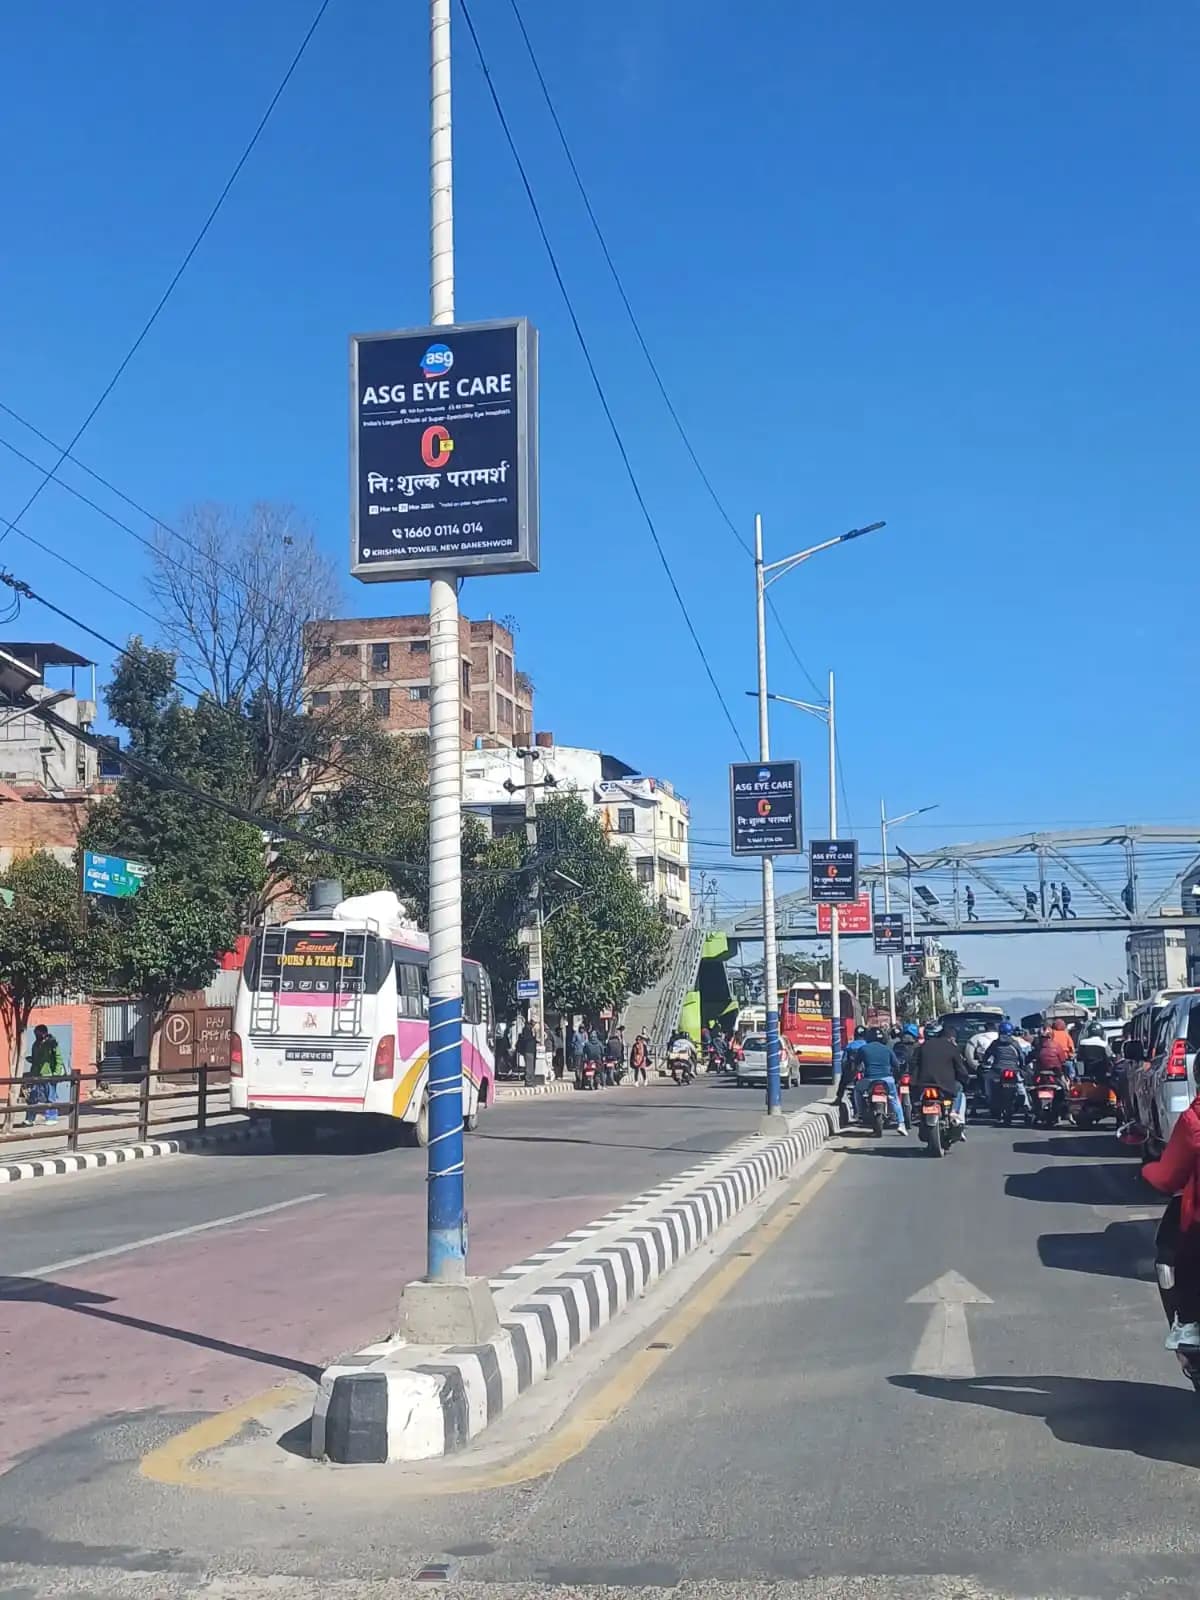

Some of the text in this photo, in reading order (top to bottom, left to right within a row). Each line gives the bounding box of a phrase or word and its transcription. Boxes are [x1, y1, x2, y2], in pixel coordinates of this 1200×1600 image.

[426, 351, 453, 367] asg
[362, 374, 512, 405] ASG EYE CARE
[447, 461, 510, 487] परामर्श
[404, 522, 483, 539] 1660 0114 014
[372, 539, 513, 556] KRISHNA TOWER, NEW BANESHWOR
[735, 781, 792, 791] ASG EYE CARE
[305, 955, 313, 966] &
